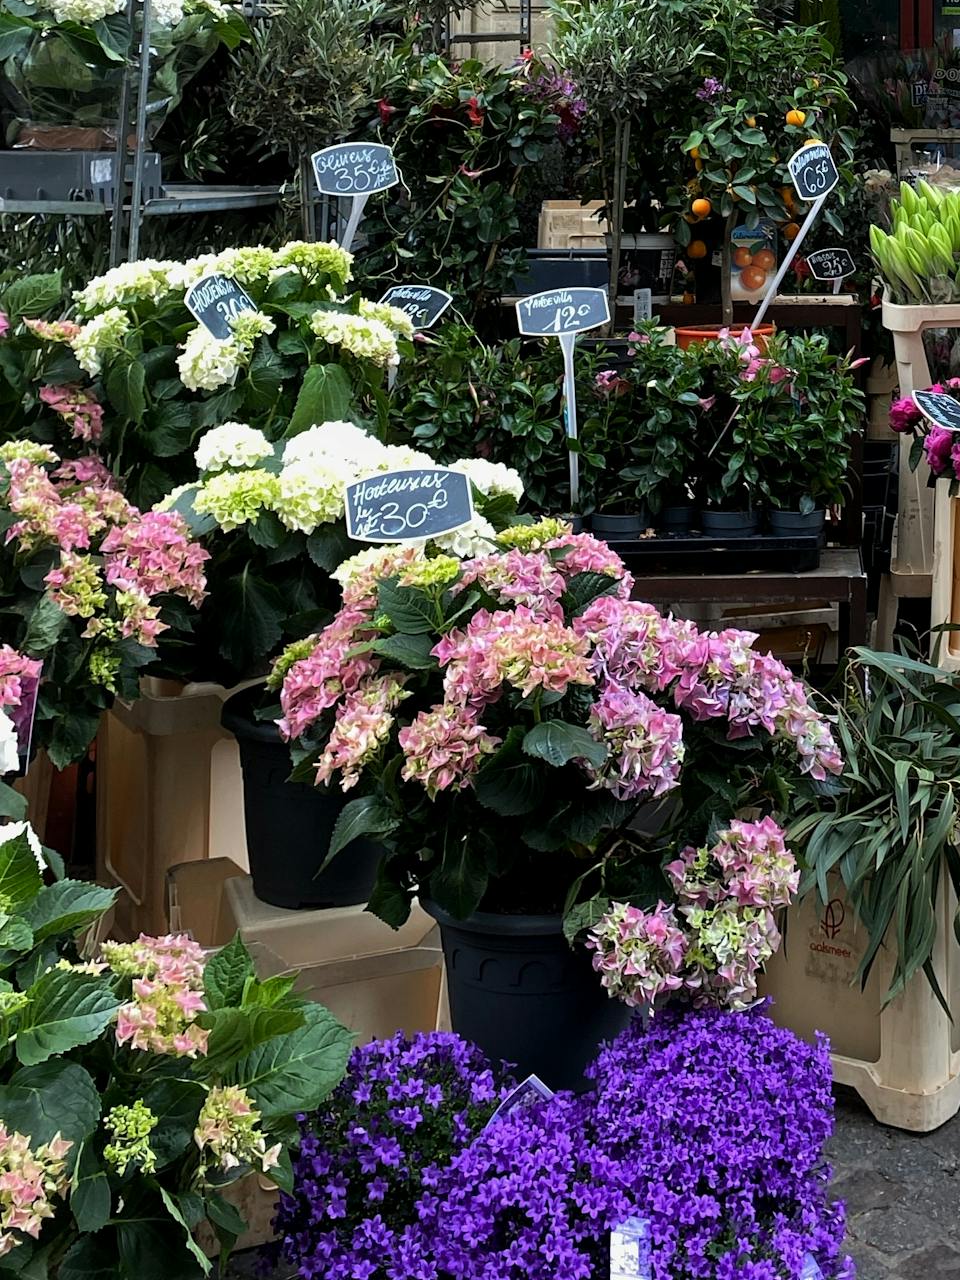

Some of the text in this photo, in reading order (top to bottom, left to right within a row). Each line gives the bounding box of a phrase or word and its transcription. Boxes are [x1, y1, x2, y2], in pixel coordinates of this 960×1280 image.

[541, 304, 591, 332] 12€
[353, 472, 450, 506] Hortensias
[380, 488, 449, 535] 30€
